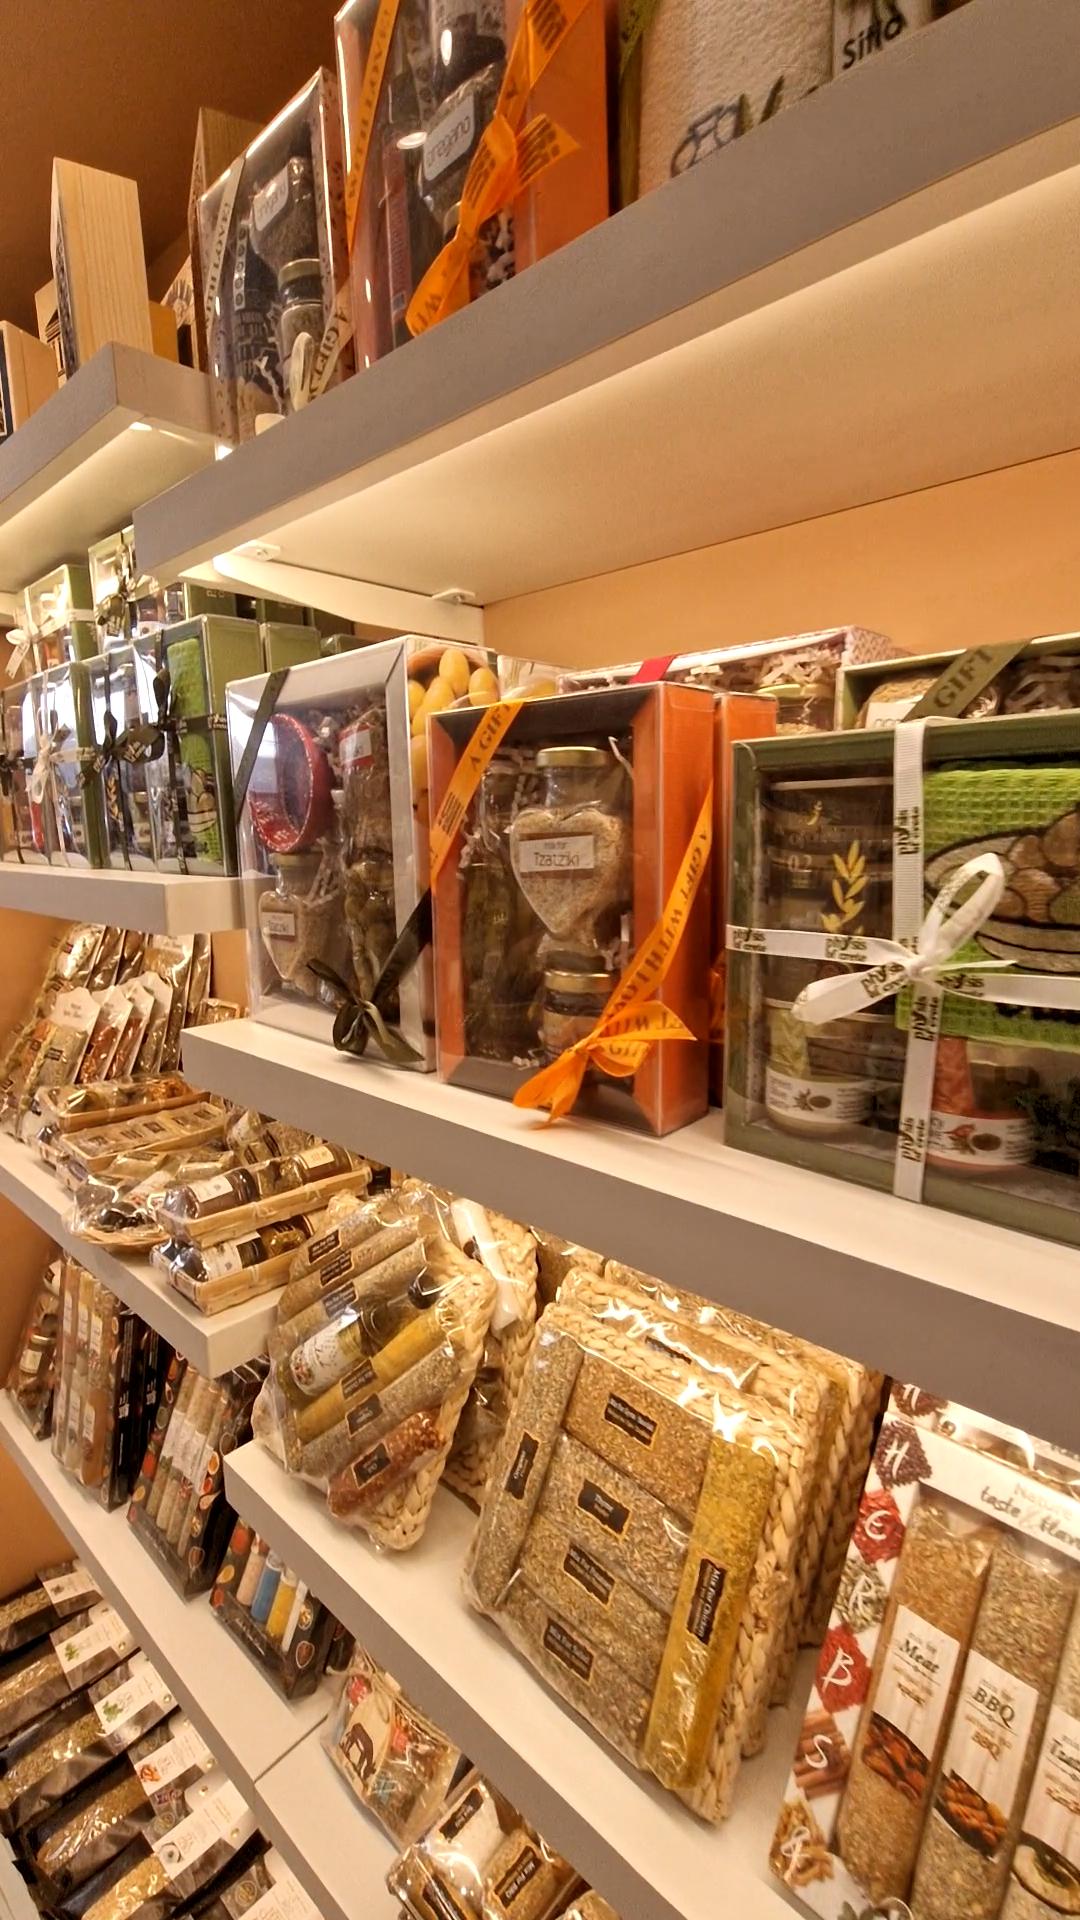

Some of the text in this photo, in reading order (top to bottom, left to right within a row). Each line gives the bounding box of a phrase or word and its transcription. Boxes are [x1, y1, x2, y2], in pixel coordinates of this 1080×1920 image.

[934, 648, 993, 708] GIFT
[680, 848, 703, 904] GIFT
[647, 908, 683, 973] WITH
[980, 1485, 1021, 1518] taste
[711, 1568, 721, 1586] Mix
[699, 1603, 713, 1638] Chicken
[898, 1639, 940, 1674] Meat
[971, 1685, 1015, 1730] BBQ
